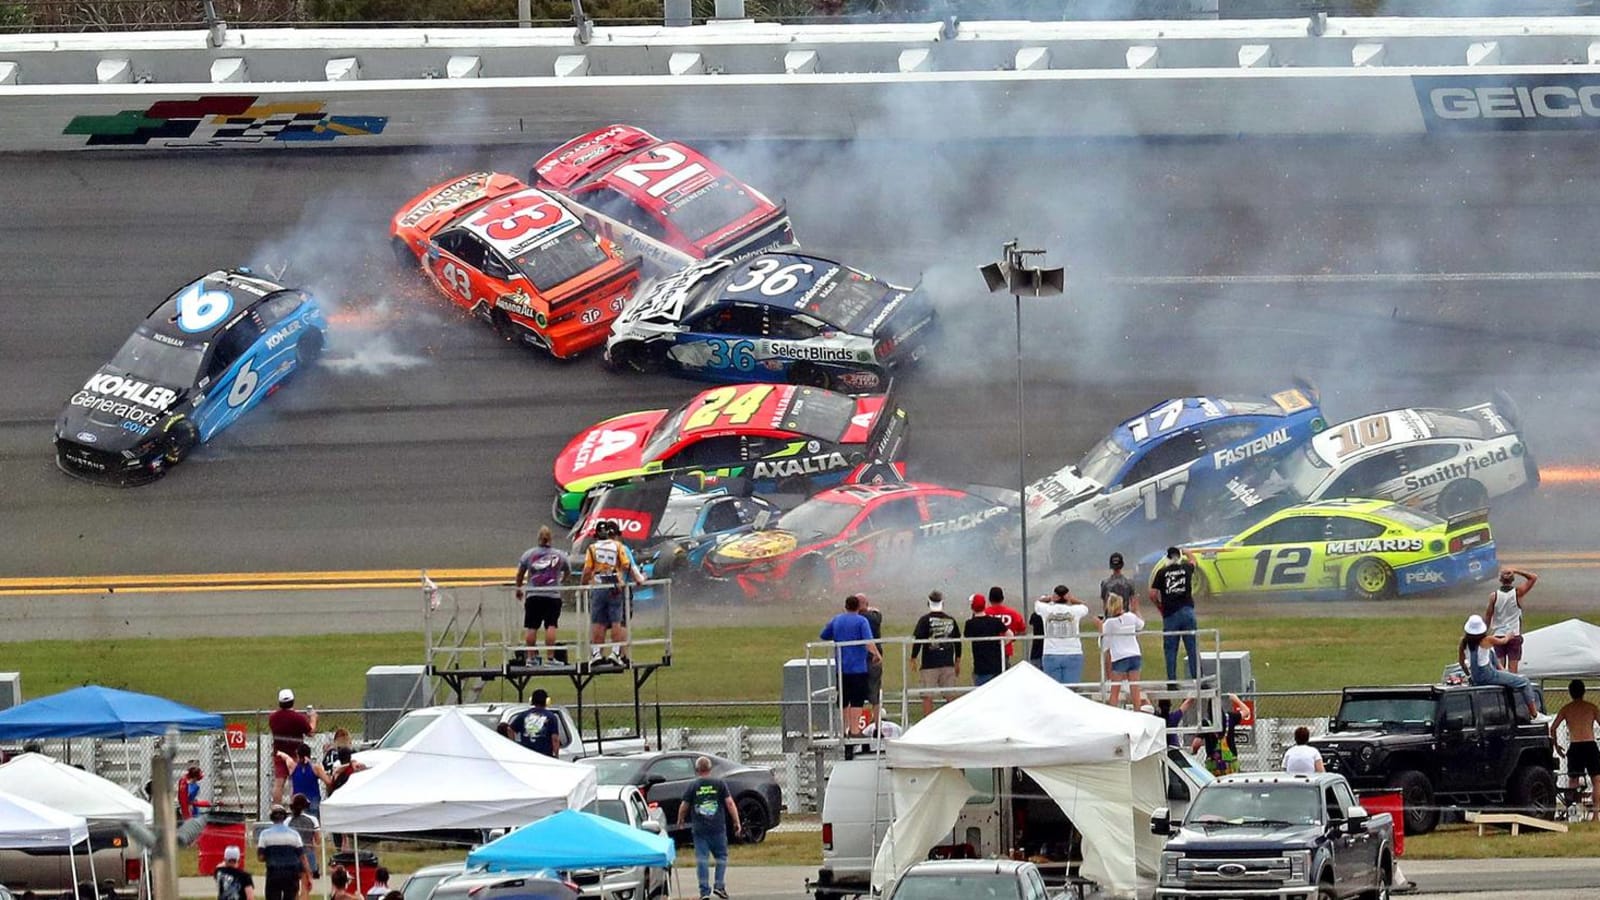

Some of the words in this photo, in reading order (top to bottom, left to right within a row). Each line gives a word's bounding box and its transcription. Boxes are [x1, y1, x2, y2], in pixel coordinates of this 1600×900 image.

[613, 146, 706, 198] 21
[472, 195, 564, 241] 43
[442, 261, 473, 300] 43
[726, 258, 813, 297] 36
[176, 277, 235, 333] 6
[582, 308, 600, 324] STP
[612, 296, 625, 311] ST
[152, 332, 185, 348] NEWMAN
[265, 320, 302, 350] KOHLER
[770, 343, 854, 361] SelectBlinds
[707, 339, 756, 372] 36
[83, 373, 178, 412] KOHLER
[228, 356, 259, 409] 6
[70, 391, 160, 428] Generators
[683, 385, 777, 431] 24
[1127, 398, 1185, 443] 17
[1214, 426, 1292, 470] FASTENAL
[1329, 415, 1392, 459] 10
[753, 452, 849, 480] AXALTA
[1404, 446, 1508, 492] Smithfield
[1327, 539, 1424, 555] MENARDS
[1252, 547, 1313, 587] 12
[1405, 569, 1446, 584] PEAK
[229, 730, 243, 744] 73
[858, 715, 867, 729] 5
